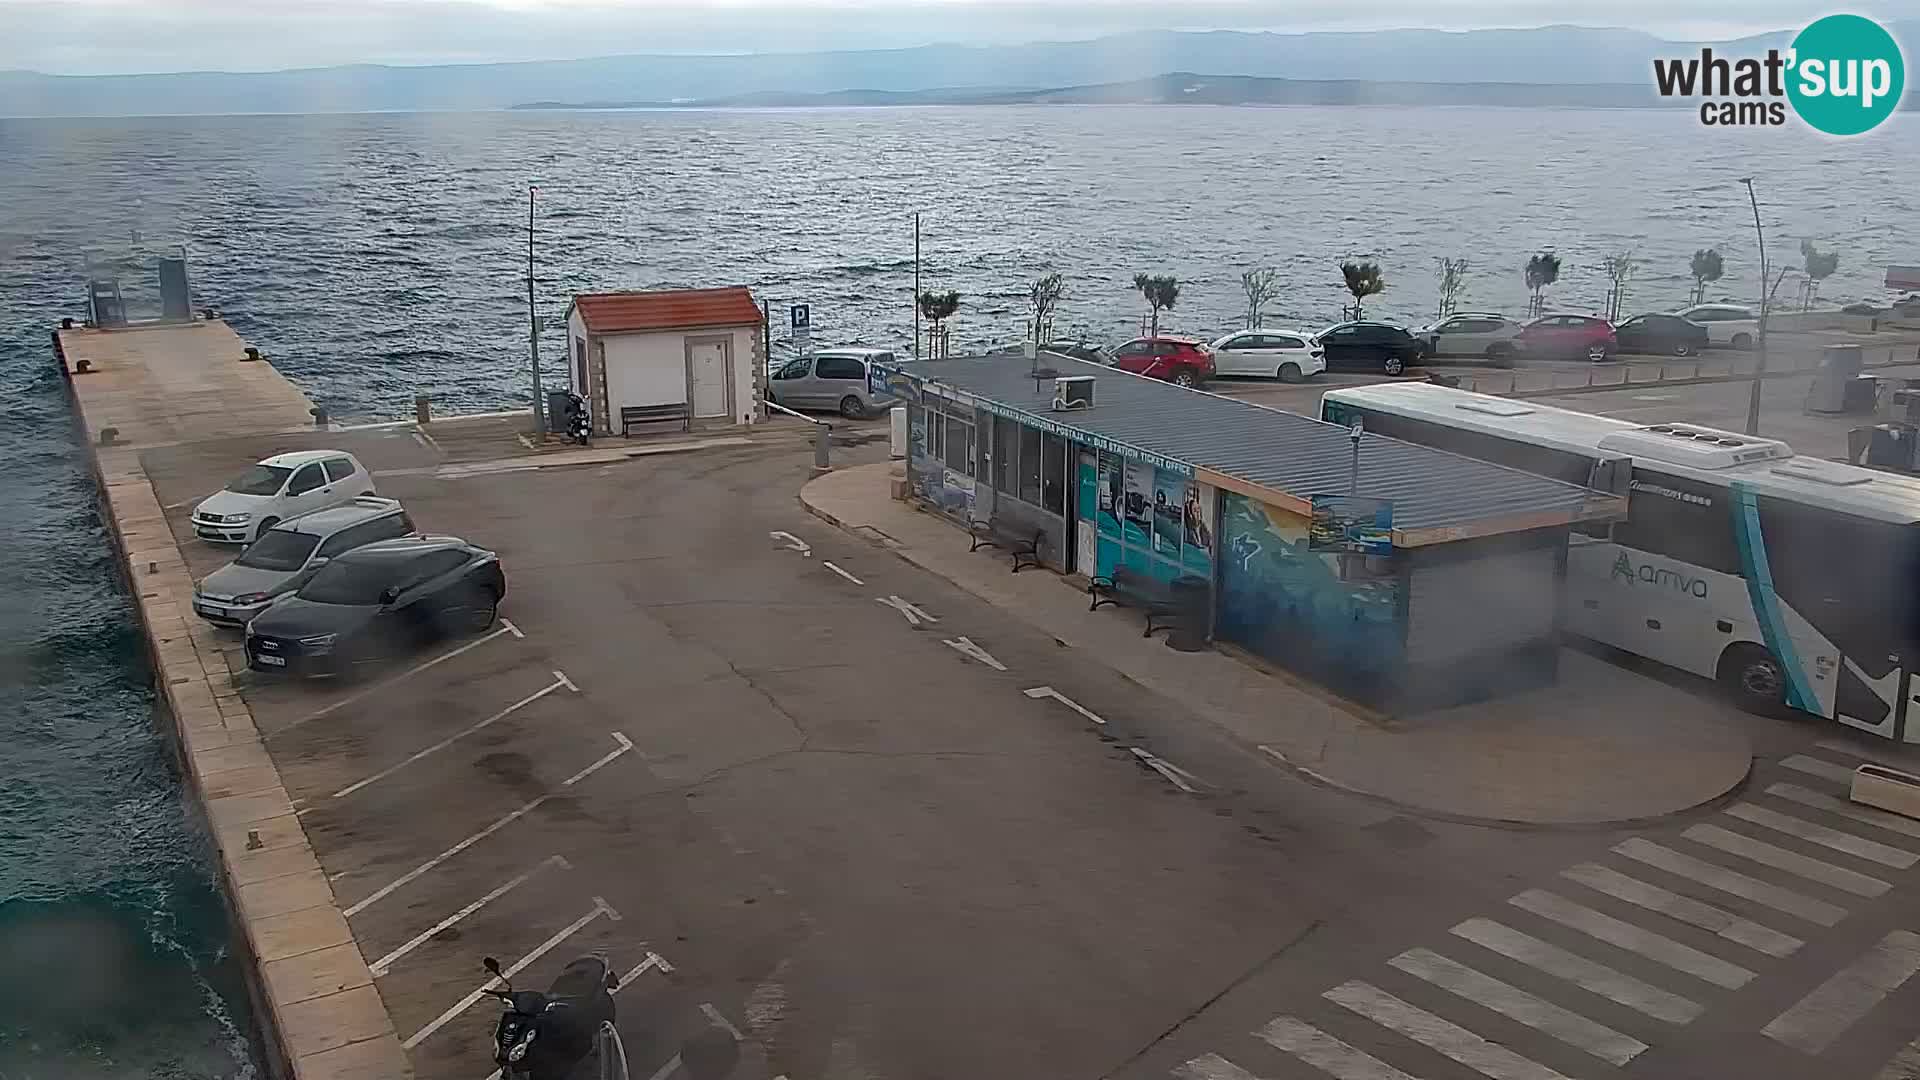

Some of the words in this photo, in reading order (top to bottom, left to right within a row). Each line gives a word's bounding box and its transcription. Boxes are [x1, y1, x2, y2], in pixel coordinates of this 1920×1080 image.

[795, 308, 805, 325] P
[1056, 426, 1085, 441] POSTAJA
[1093, 436, 1108, 450] BUS
[1108, 441, 1138, 459] STATION
[1141, 451, 1164, 468] TICKET
[1165, 461, 1191, 476] OFFICE
